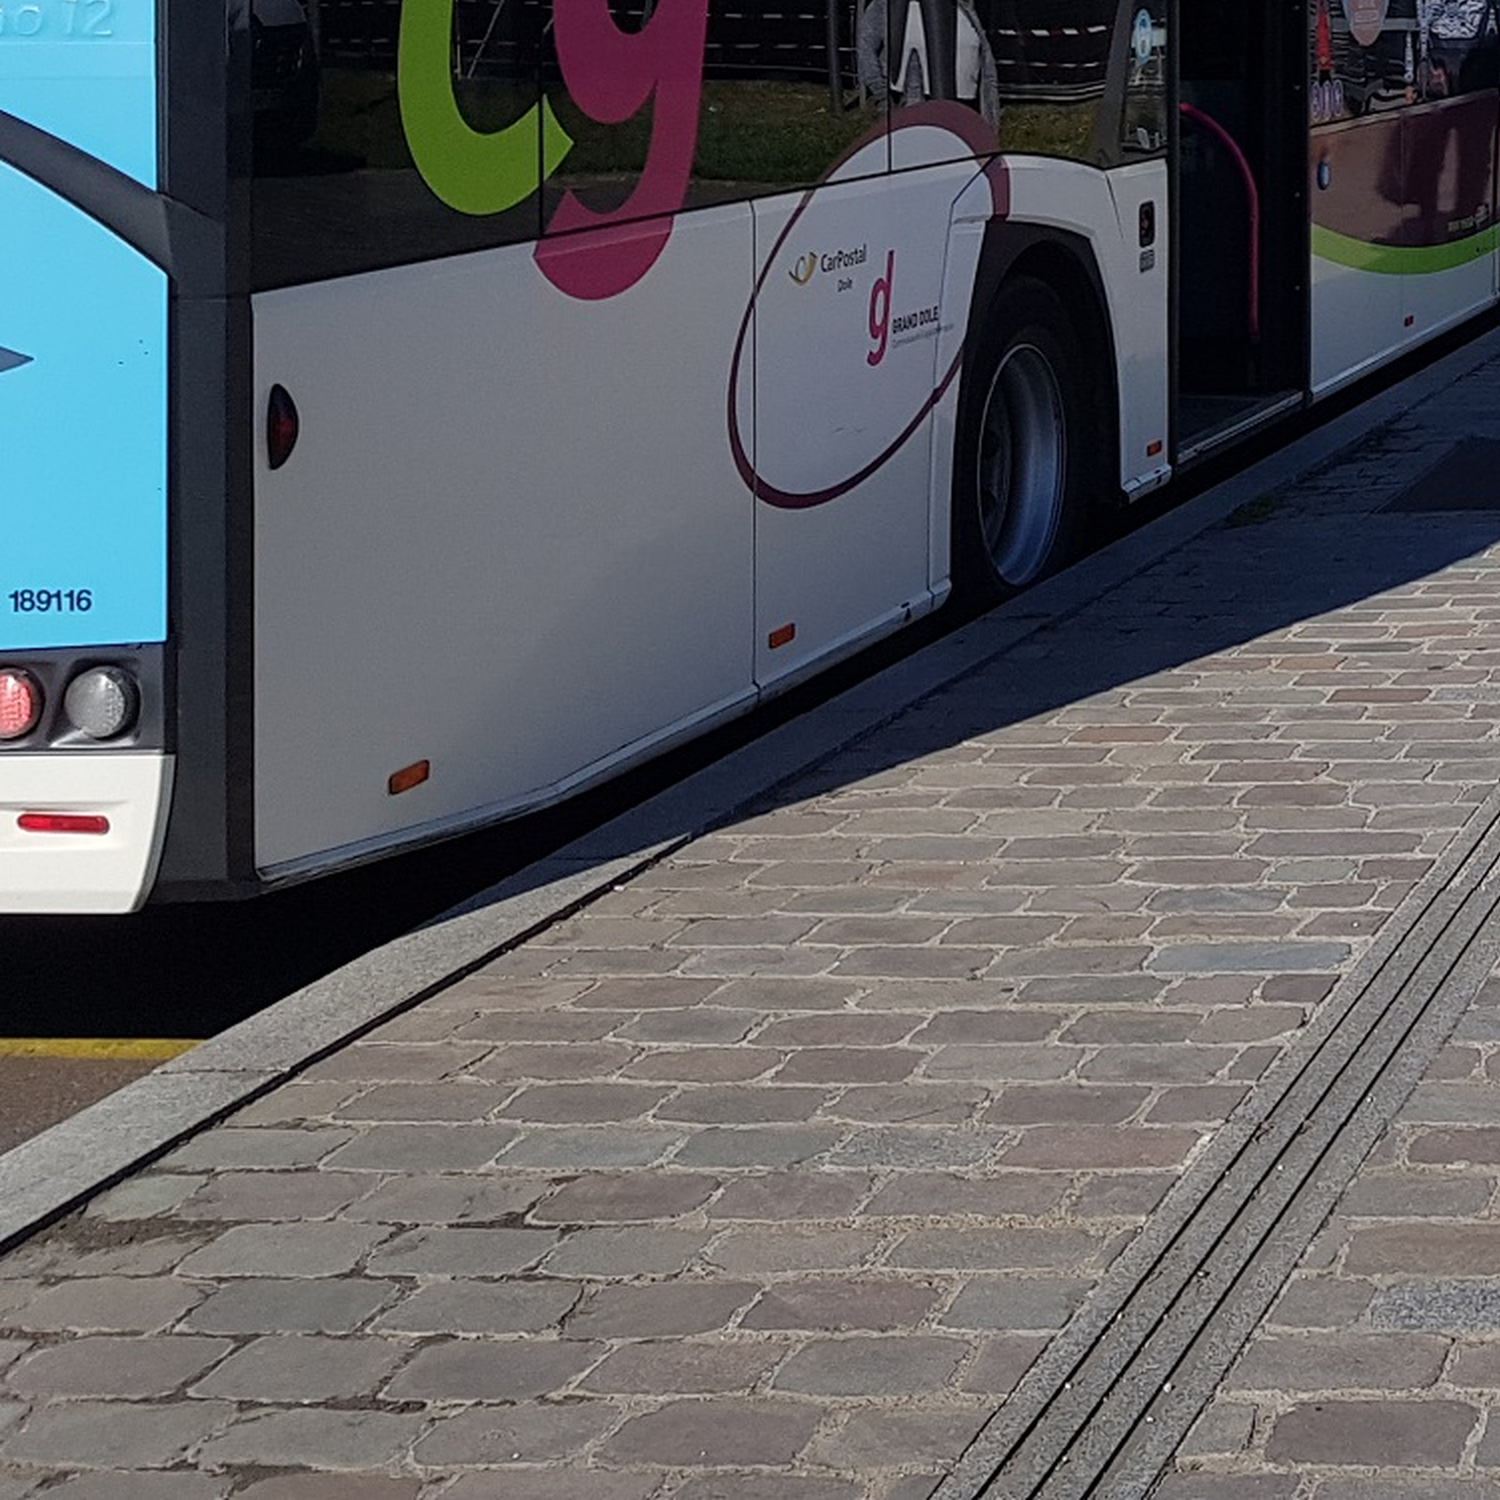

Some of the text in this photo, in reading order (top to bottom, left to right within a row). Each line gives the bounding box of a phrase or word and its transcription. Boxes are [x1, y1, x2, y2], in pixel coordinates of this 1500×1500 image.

[820, 244, 867, 273] CarPostal
[892, 306, 940, 334] GRAND DOLE
[8, 589, 92, 612] 189116
